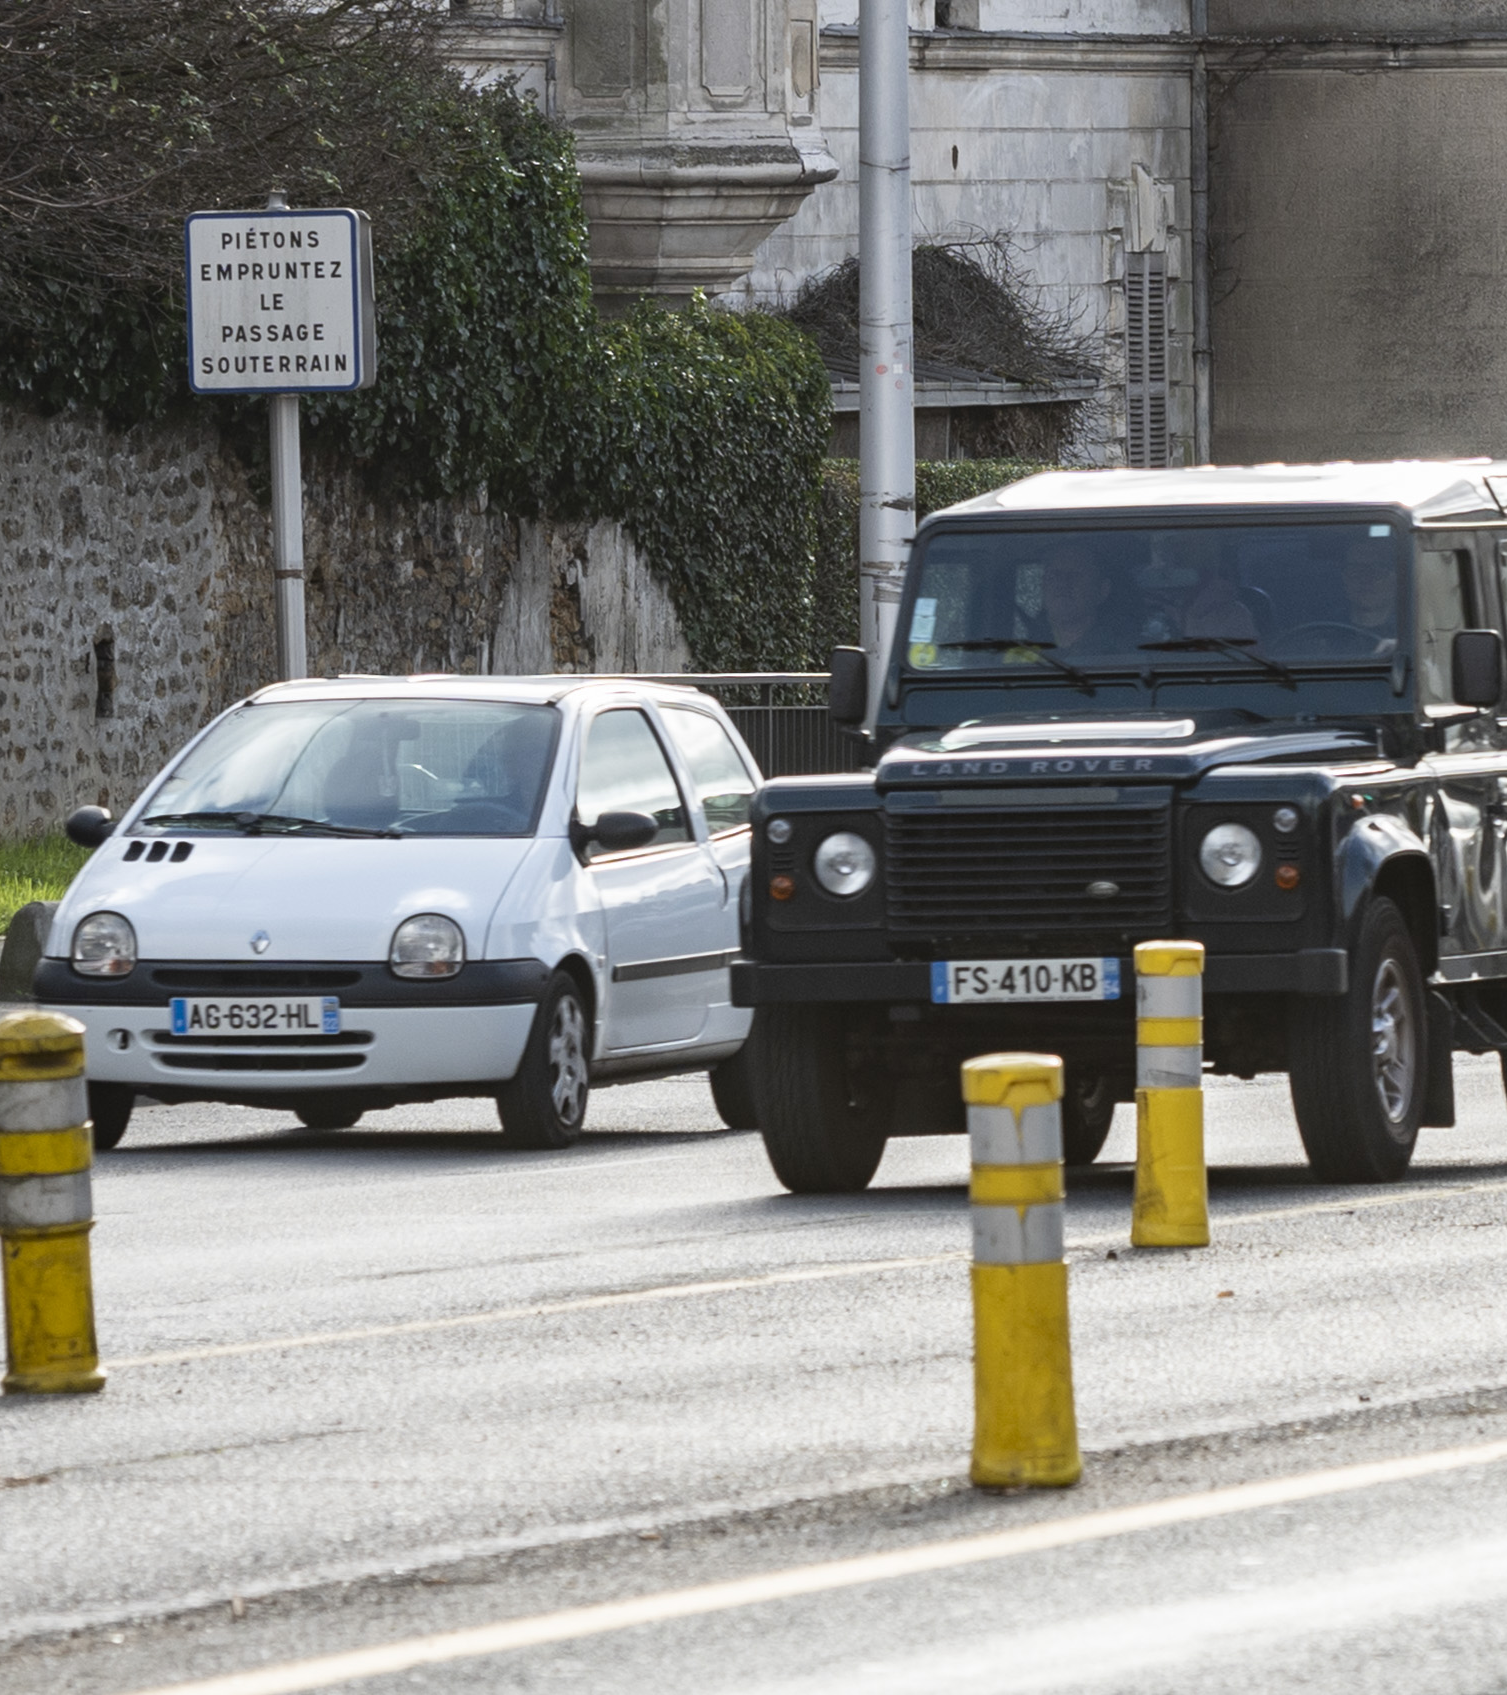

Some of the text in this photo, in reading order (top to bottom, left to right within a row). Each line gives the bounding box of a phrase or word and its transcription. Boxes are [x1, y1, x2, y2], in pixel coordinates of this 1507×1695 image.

[221, 227, 320, 250] PIÉTONS
[200, 261, 342, 281] EMPRUNTEZ
[260, 293, 284, 311] LE
[222, 323, 325, 342] PASSAGE
[201, 354, 347, 374] SOUTERRAIN
[910, 757, 1154, 776] LAND ROVER
[953, 963, 1097, 995] FS-410-KB
[188, 1004, 319, 1029] AG-632-HL
